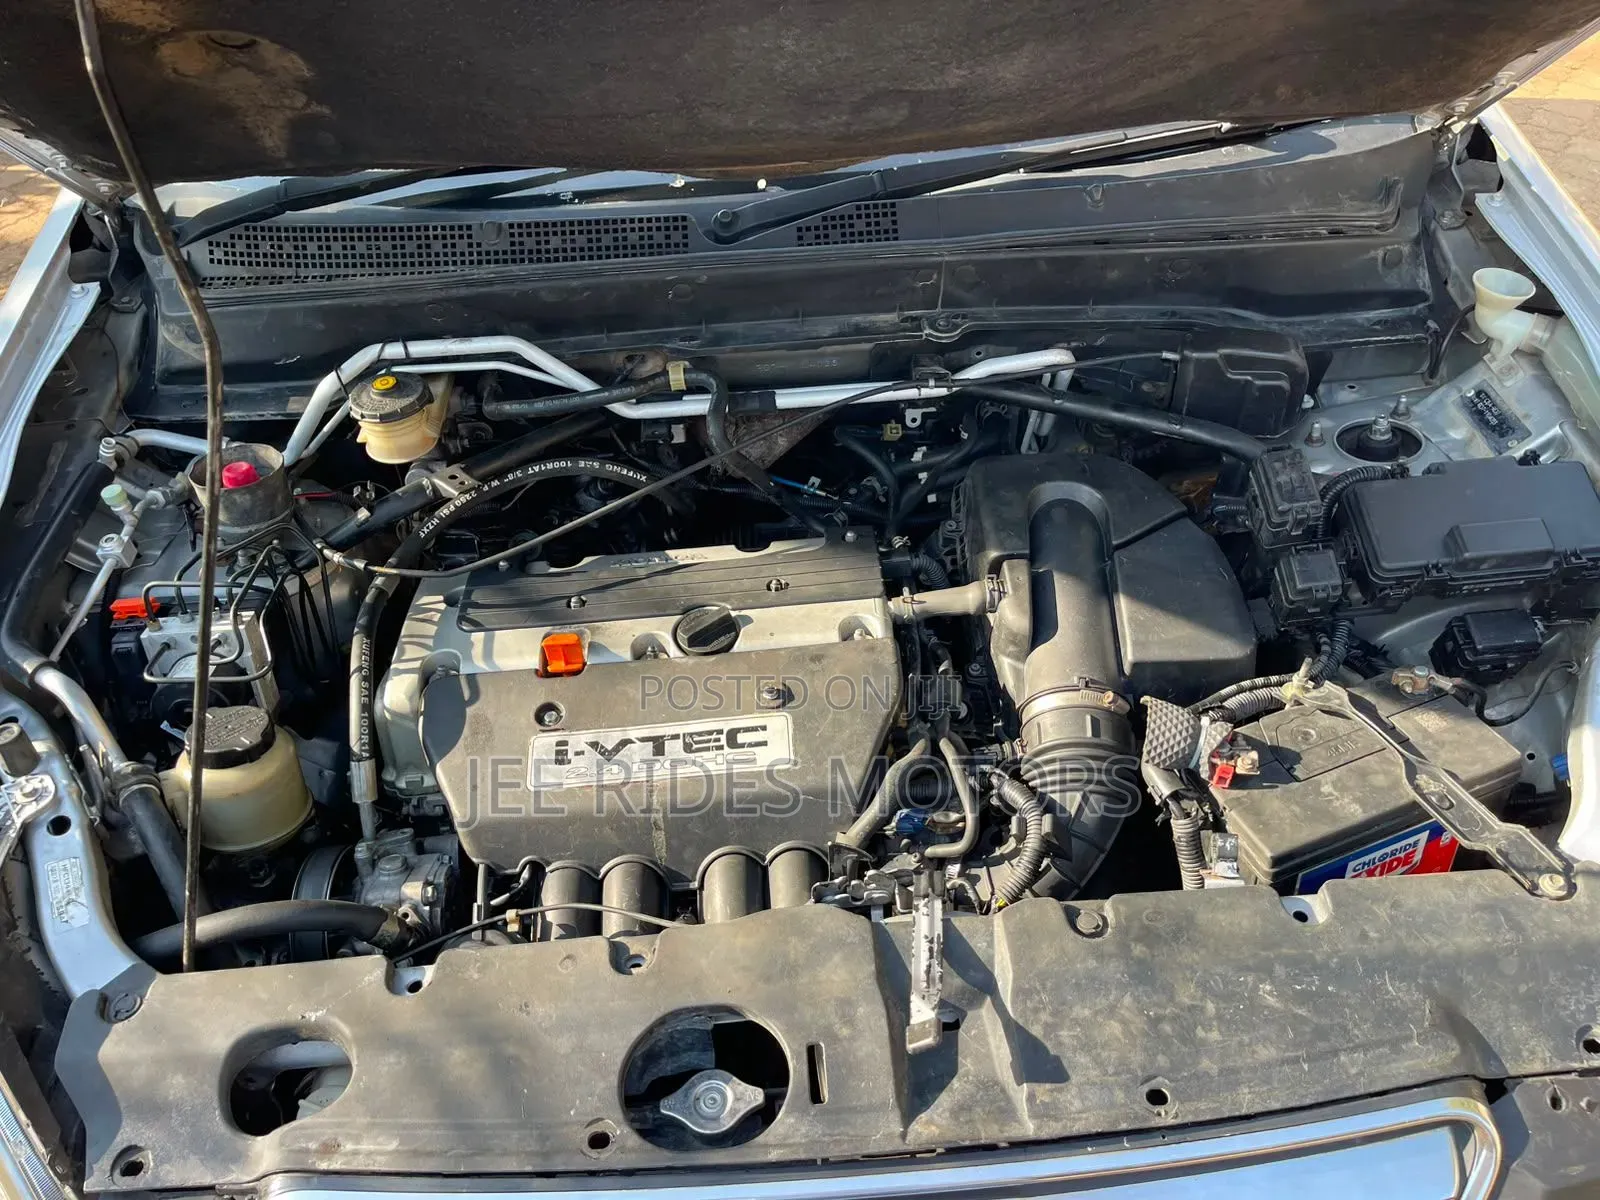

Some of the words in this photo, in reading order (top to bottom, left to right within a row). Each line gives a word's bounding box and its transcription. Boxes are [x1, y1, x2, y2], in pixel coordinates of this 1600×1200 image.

[527, 460, 572, 474] 100R1AT
[605, 463, 647, 482] XUFENG
[454, 490, 478, 507] 2250
[440, 504, 456, 518] PSI
[361, 637, 371, 676] XUFENG
[361, 681, 369, 705] SAE
[554, 724, 768, 766] i-VTEC
[1352, 838, 1420, 873] CHLORIDE
